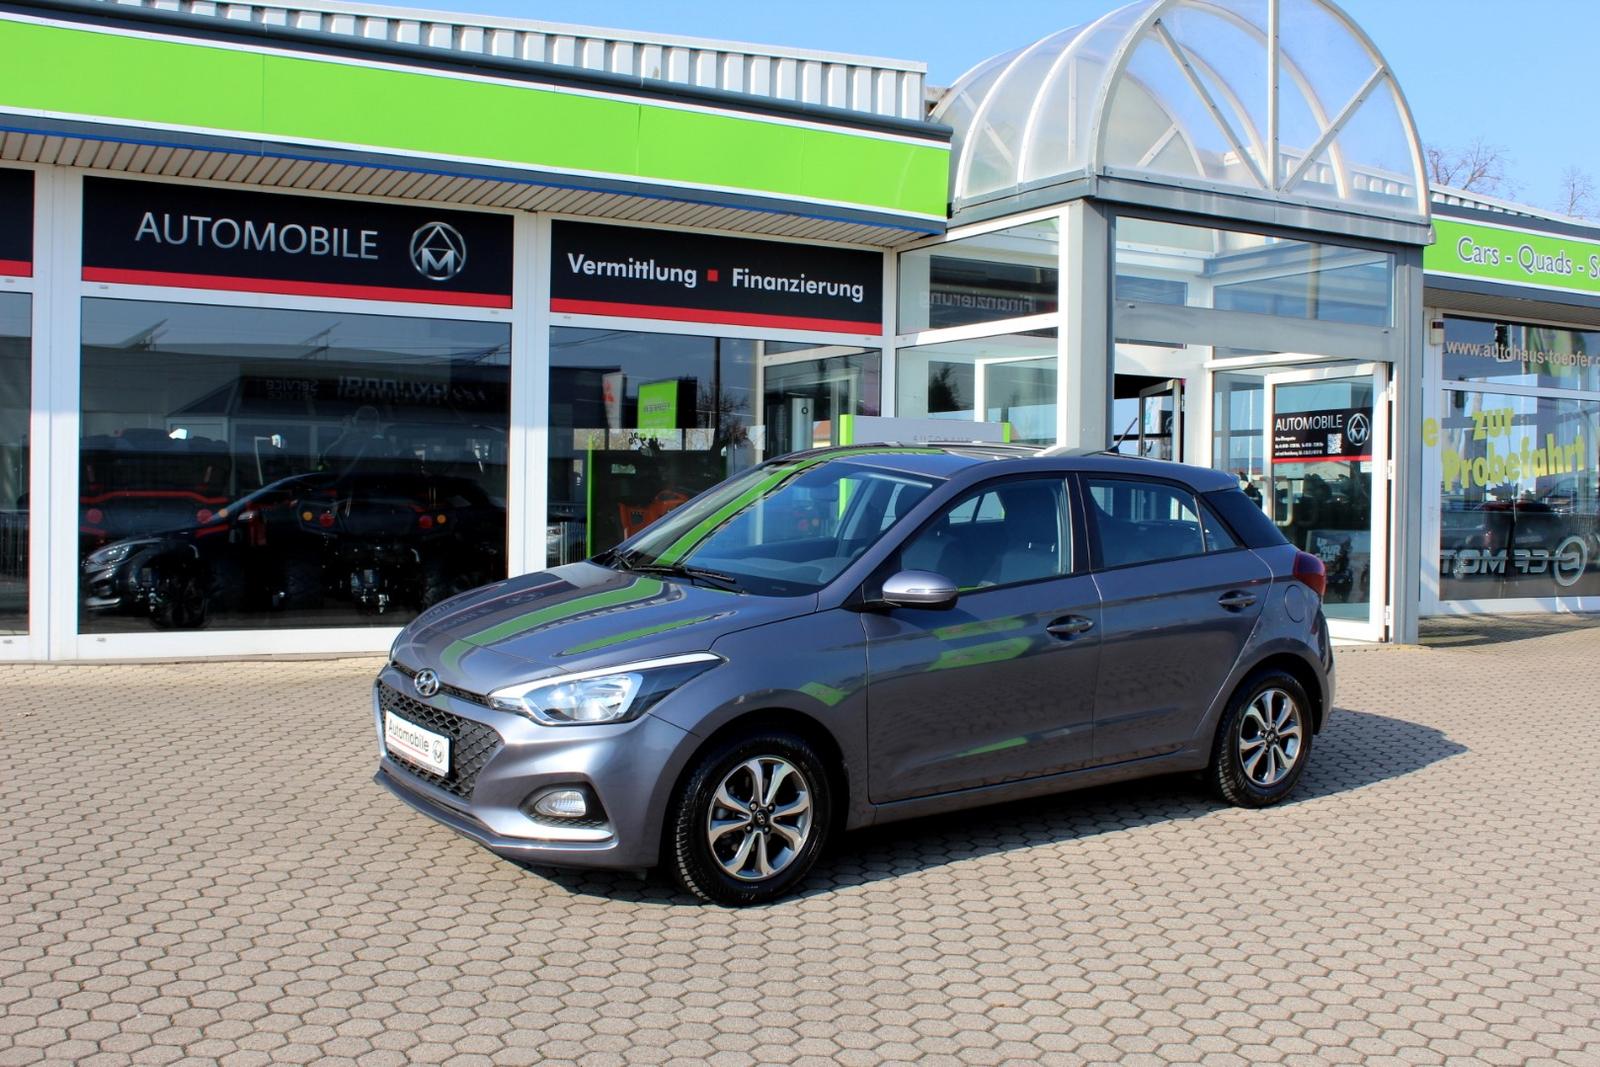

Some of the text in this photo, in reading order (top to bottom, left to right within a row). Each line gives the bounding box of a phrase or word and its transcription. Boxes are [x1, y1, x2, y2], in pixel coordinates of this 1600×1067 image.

[134, 211, 379, 261] AUTOMOBILE
[1457, 236, 1500, 265] Cars
[1517, 245, 1573, 275] Quads
[1589, 255, 1600, 279] S
[567, 252, 865, 303] Vermittlung Finanzierung
[1275, 414, 1343, 432] AUTOMOBILE
[1472, 407, 1515, 441] zur
[1441, 433, 1586, 492] Probefahrt
[388, 717, 430, 753] Automobile
